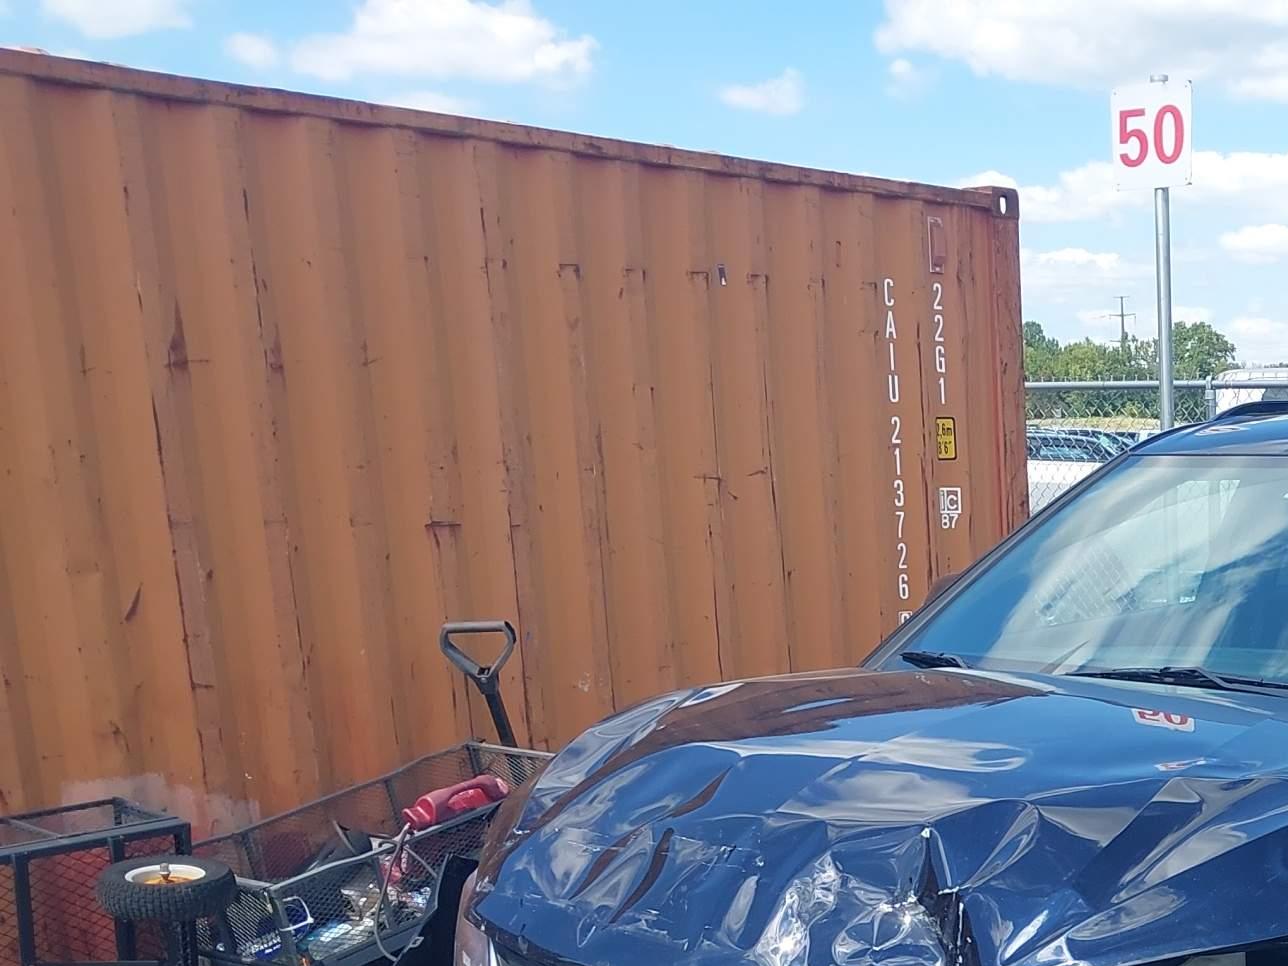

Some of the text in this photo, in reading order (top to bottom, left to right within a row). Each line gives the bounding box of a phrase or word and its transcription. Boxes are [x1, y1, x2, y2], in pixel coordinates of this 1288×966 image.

[1119, 104, 1184, 168] 50
[884, 278, 899, 403] CAIU
[933, 283, 946, 405] 22G1
[941, 514, 958, 529] 87
